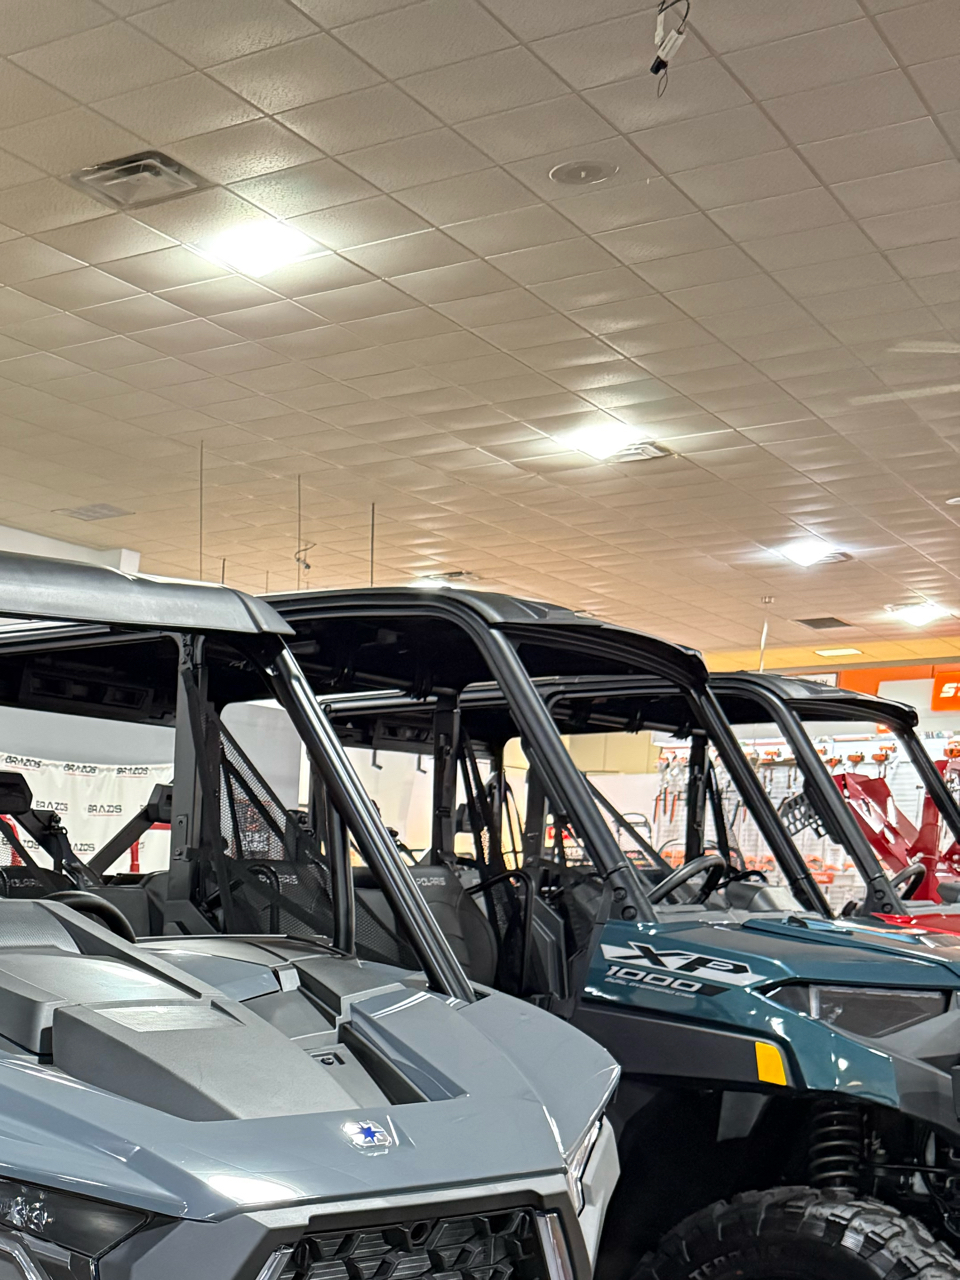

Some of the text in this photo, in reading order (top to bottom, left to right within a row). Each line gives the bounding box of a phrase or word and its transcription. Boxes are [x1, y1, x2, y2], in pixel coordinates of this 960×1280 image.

[5, 756, 42, 768] BRAZOS
[63, 763, 97, 774] BRAZOS
[117, 767, 149, 776] BRAZOS
[36, 800, 68, 812] BRAZOS
[88, 804, 122, 814] BRAZOS
[416, 877, 446, 886] POLARIS
[606, 941, 753, 976] XP
[604, 965, 702, 993] 1000
